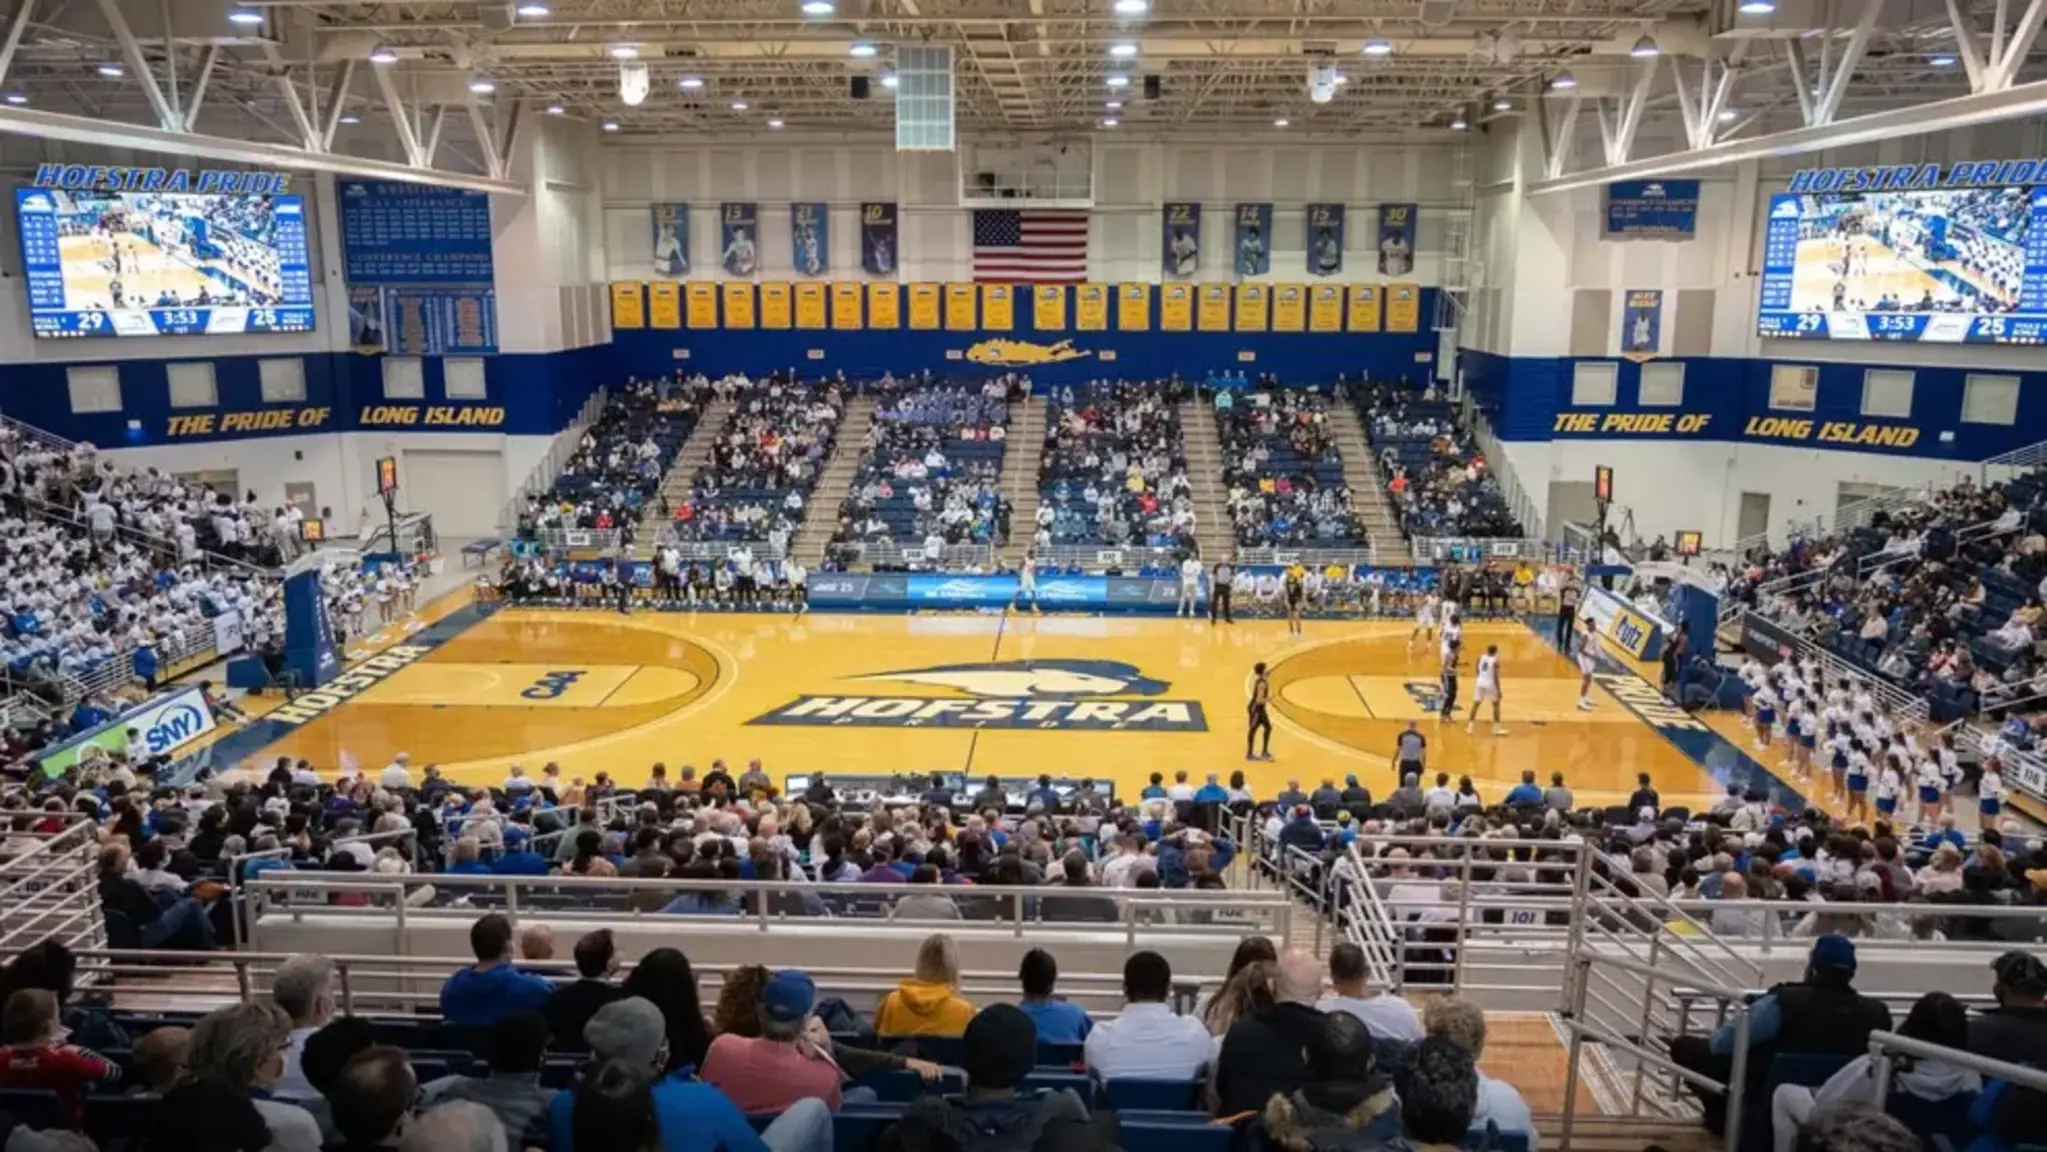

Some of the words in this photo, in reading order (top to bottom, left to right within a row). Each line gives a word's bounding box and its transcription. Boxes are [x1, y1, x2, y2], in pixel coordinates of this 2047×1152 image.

[35, 163, 189, 191] HOFSTRA
[197, 170, 291, 194] PRIDE
[1788, 163, 1941, 193] HOFSTRA
[78, 311, 104, 330] 29
[164, 311, 198, 325] 3:53
[254, 310, 277, 326] 25
[1796, 314, 1821, 331] 29
[1879, 316, 1915, 330] 3:53
[1977, 318, 2006, 335] 25
[166, 414, 215, 436] THE
[219, 409, 294, 432] PRIDE
[298, 407, 331, 427] OF
[359, 406, 420, 425] LONG
[424, 406, 505, 426] ISLAND
[1553, 413, 1599, 432] THE
[1600, 413, 1675, 433] PRIDE
[1677, 413, 1712, 432] OF
[1744, 416, 1813, 439] LONG
[1817, 421, 1920, 447] ISLAND
[266, 644, 432, 724] HOFSTRA
[780, 696, 1192, 723] HOFSTRA
[146, 712, 189, 752] SNY
[1511, 911, 1537, 925] 101
